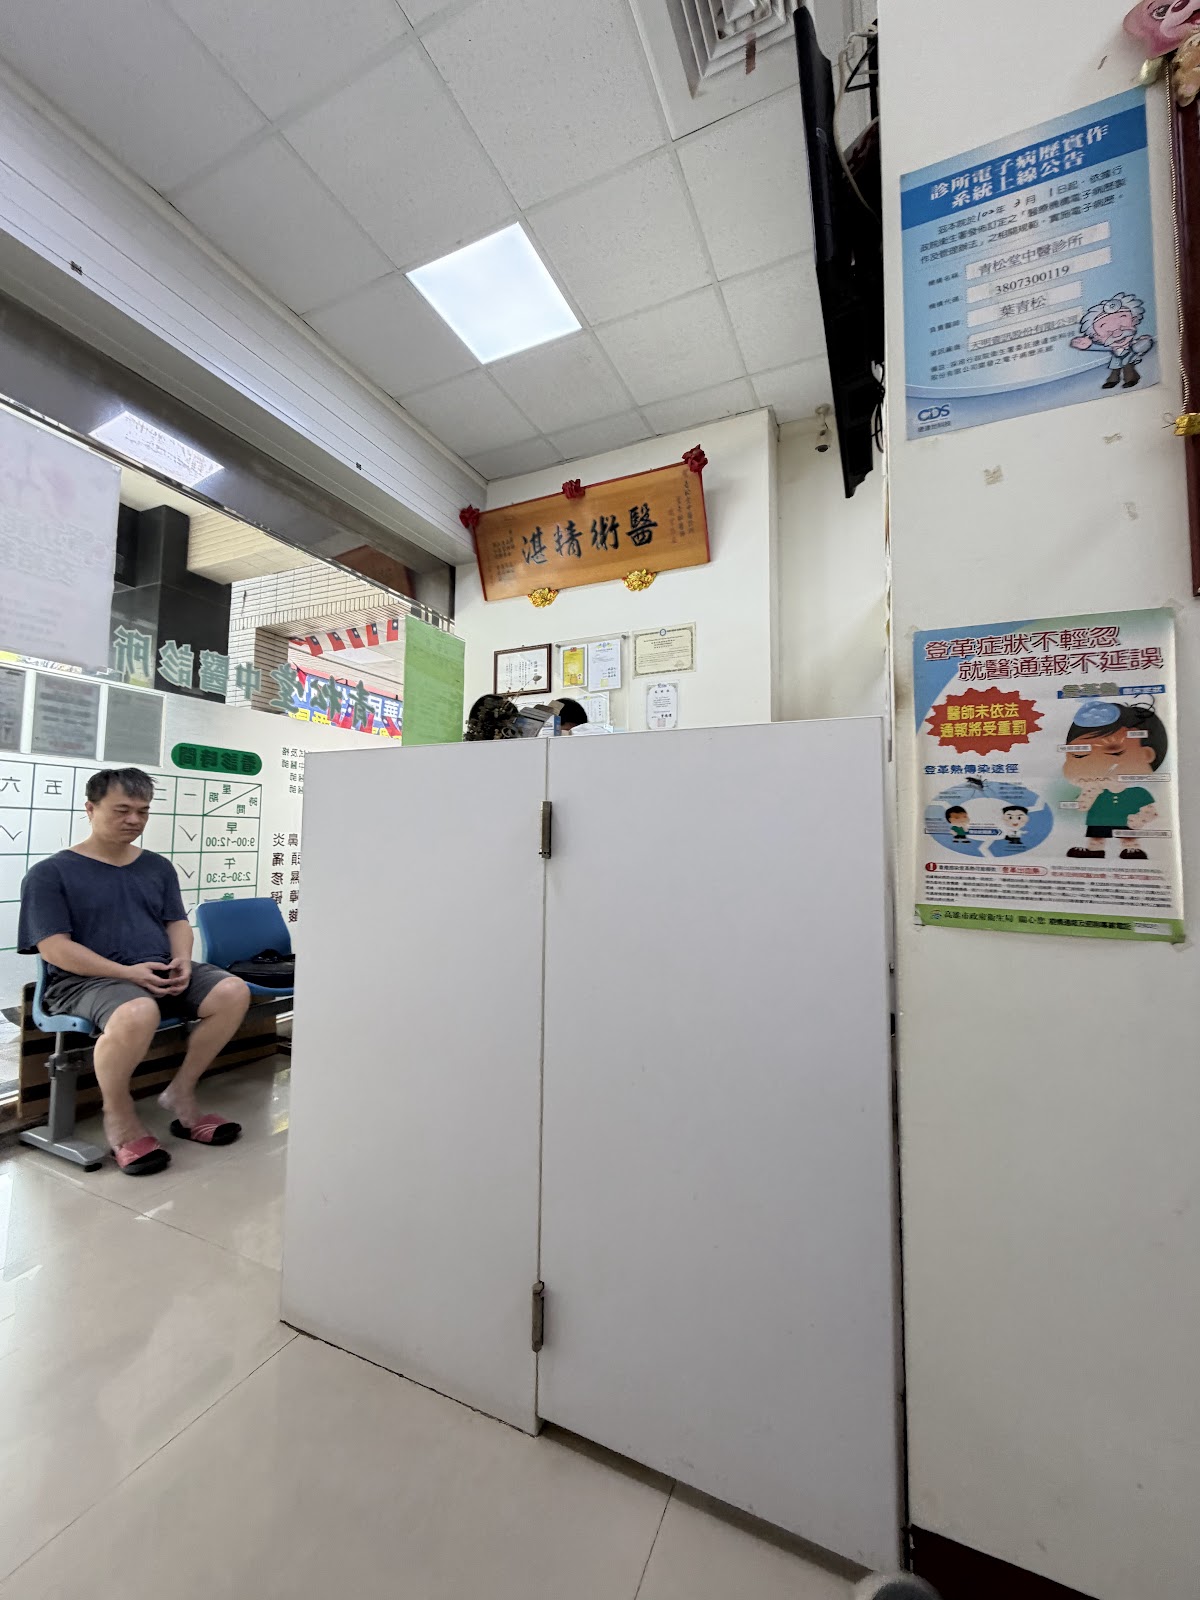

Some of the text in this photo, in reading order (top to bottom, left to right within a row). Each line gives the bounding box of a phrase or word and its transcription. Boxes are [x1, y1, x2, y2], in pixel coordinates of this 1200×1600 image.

[930, 124, 1109, 201] 診所電子病歷實作
[952, 151, 1085, 207] 系統上線公告
[995, 265, 1070, 294] 3807300119
[1000, 295, 1047, 318] 葉青松
[917, 404, 950, 421] CDS
[925, 626, 1120, 660] 登革症狀不輕忽
[958, 647, 1164, 681] 就醫通報不延誤
[947, 702, 1019, 721] 醫師未依法
[939, 719, 1027, 738] 通報將受重罰
[924, 763, 1020, 775] 登革熱傳染途徑
